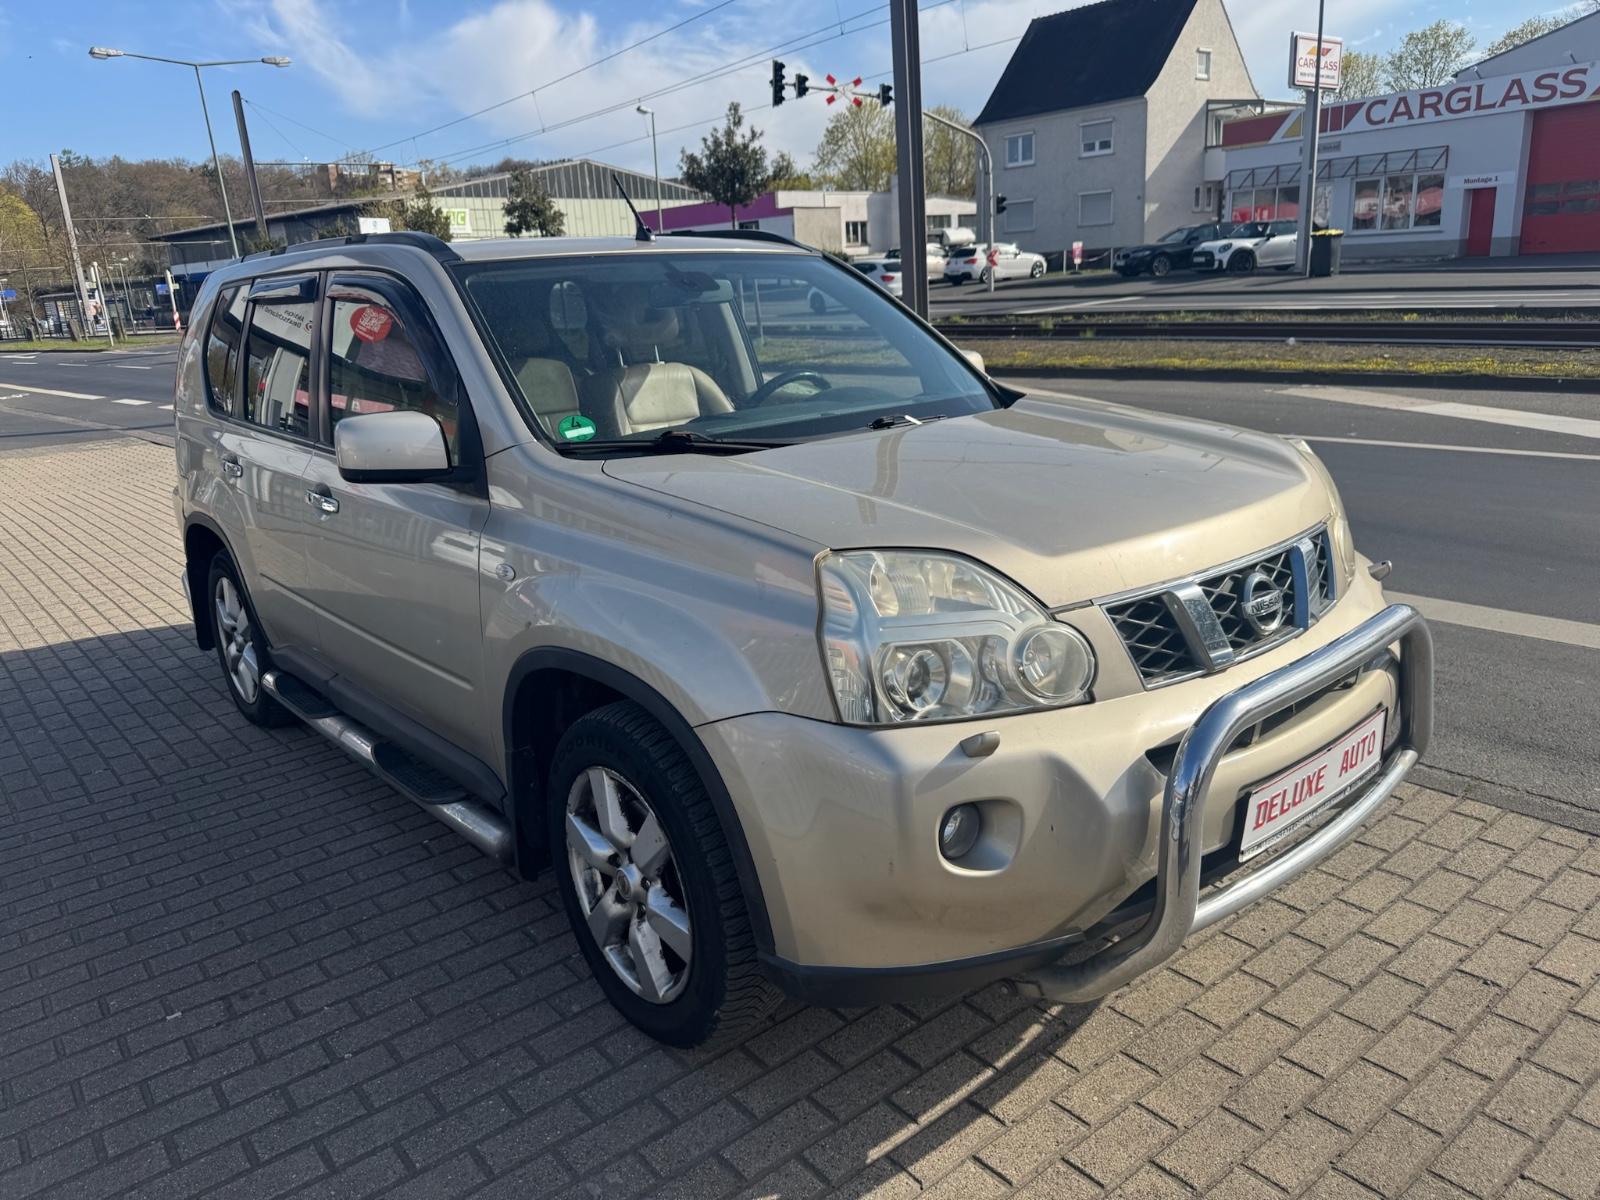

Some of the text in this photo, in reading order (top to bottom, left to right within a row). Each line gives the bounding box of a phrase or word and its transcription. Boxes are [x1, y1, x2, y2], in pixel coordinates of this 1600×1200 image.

[1298, 57, 1338, 71] CARASS
[1365, 68, 1589, 126] CARGLASS
[571, 416, 582, 429] 4
[1253, 764, 1328, 831] DELUXE
[1339, 730, 1376, 778] AUTO
